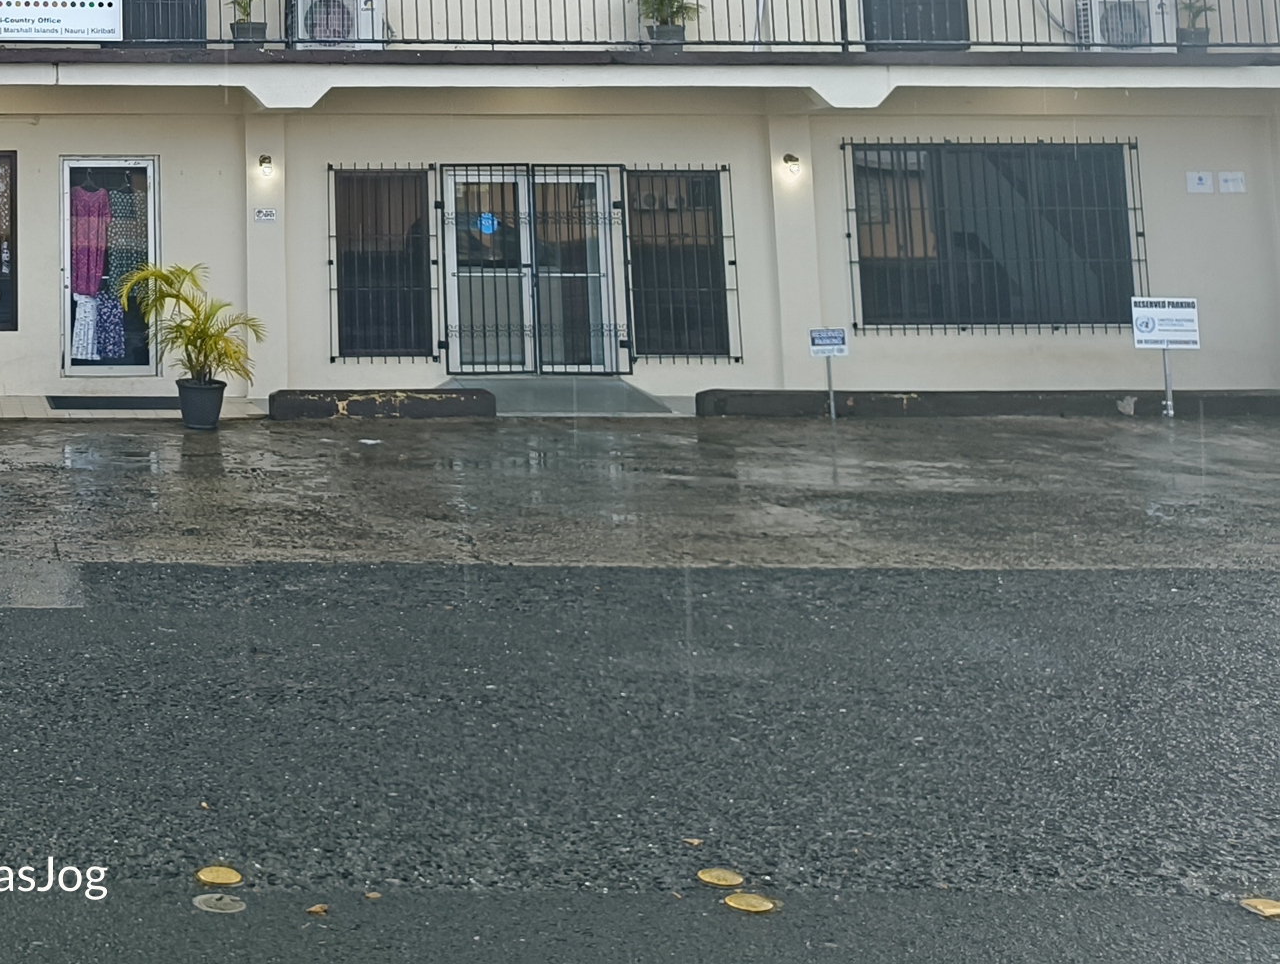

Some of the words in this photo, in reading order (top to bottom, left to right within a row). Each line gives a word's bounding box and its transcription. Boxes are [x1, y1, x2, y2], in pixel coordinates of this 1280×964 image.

[38, 16, 62, 24] Office
[3, 26, 33, 34] Marshall
[34, 26, 59, 35] Islands
[64, 27, 86, 35] Nauru
[90, 26, 116, 35] Kiribati
[1134, 301, 1166, 309] RESERVED
[1167, 301, 1195, 309] PARKING
